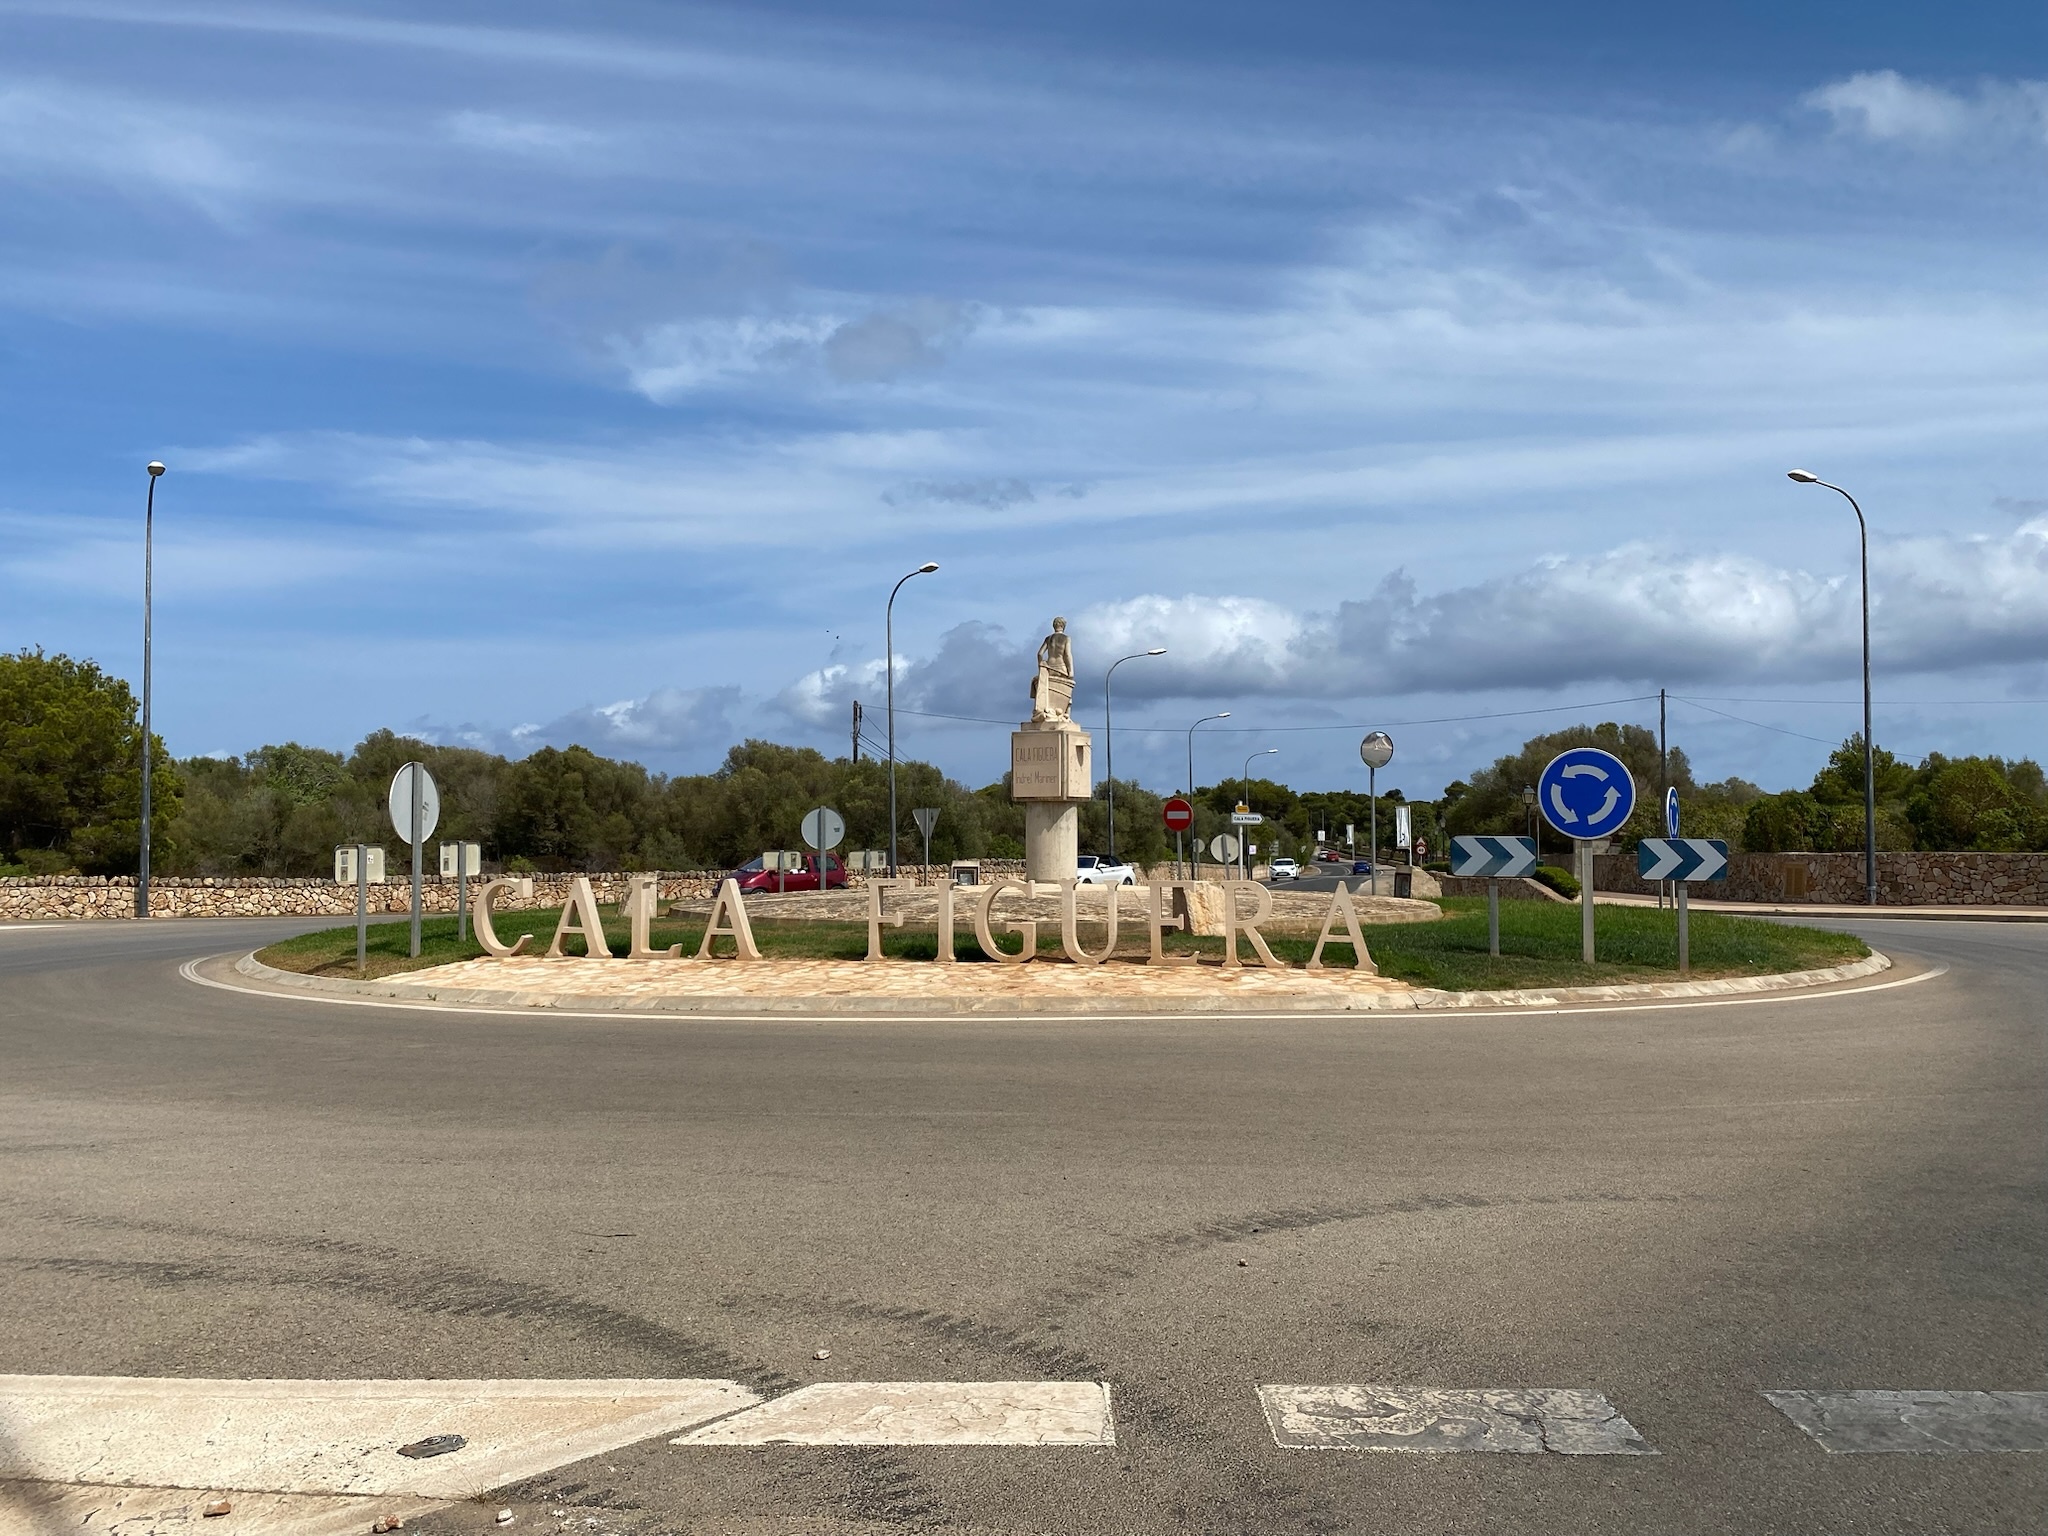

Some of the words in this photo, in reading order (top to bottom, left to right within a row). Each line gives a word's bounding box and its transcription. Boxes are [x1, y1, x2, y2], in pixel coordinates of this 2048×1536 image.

[1016, 747, 1031, 762] CALA
[1033, 746, 1057, 761] FIGUERA
[472, 877, 763, 960] CALA
[863, 877, 1379, 973] FIGUERA
